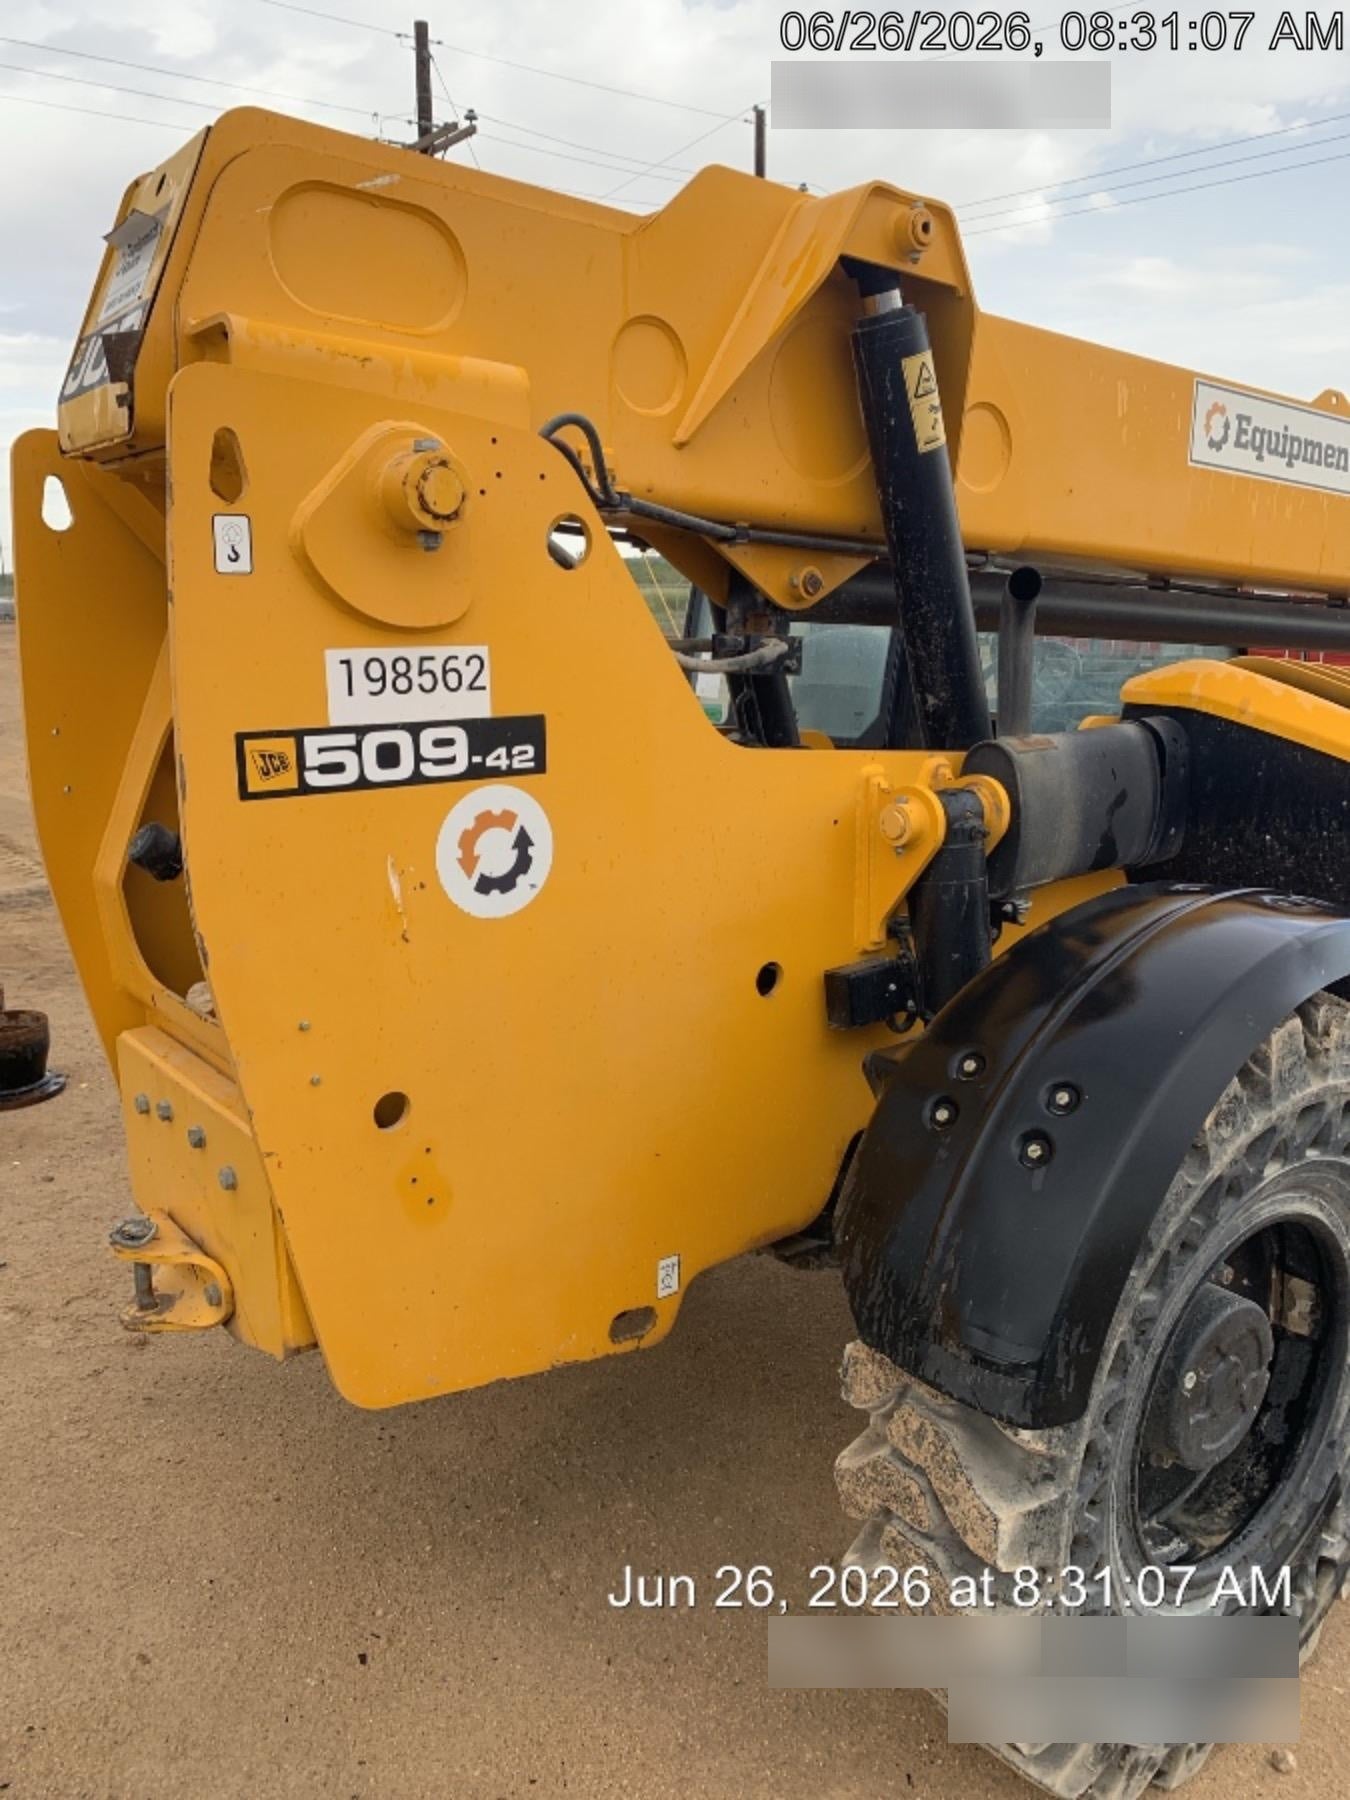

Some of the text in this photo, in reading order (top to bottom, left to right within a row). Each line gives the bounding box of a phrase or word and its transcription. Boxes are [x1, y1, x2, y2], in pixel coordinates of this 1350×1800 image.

[339, 654, 487, 697] 198562
[257, 725, 536, 787] JCB 509-42
